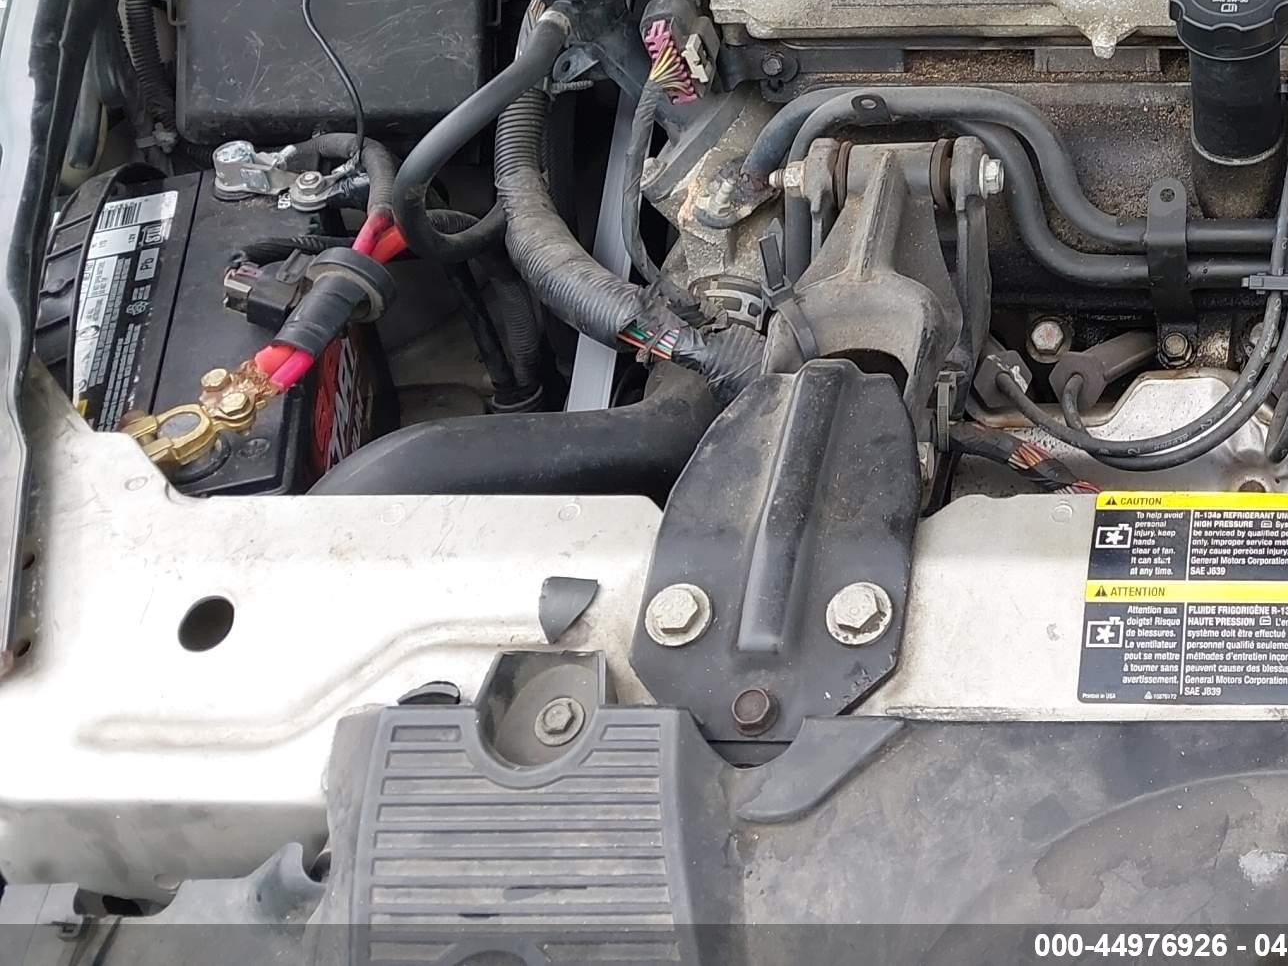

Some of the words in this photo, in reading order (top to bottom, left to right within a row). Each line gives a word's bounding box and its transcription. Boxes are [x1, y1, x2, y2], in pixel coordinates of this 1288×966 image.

[140, 257, 154, 271] Pb
[1237, 530, 1245, 538] by
[1248, 530, 1279, 538] qualified
[1139, 568, 1153, 576] any
[1207, 567, 1225, 575] J639
[1110, 587, 1165, 596] ATTENTION
[1128, 606, 1161, 614] Attention
[1127, 617, 1152, 626] doigts!
[1154, 618, 1180, 627] Risque
[1188, 618, 1214, 626] HAUTE
[1216, 618, 1255, 626] PRESSION
[1187, 630, 1219, 638] système
[1221, 630, 1236, 638] doit
[1136, 641, 1177, 649] ventilateur
[1187, 641, 1224, 650] personnel
[1186, 652, 1223, 661] méthodes
[1186, 664, 1216, 673] peuvent
[1246, 664, 1260, 672] des
[1185, 676, 1214, 684] General
[1216, 676, 1242, 684] Motors
[1185, 687, 1200, 696] SAE
